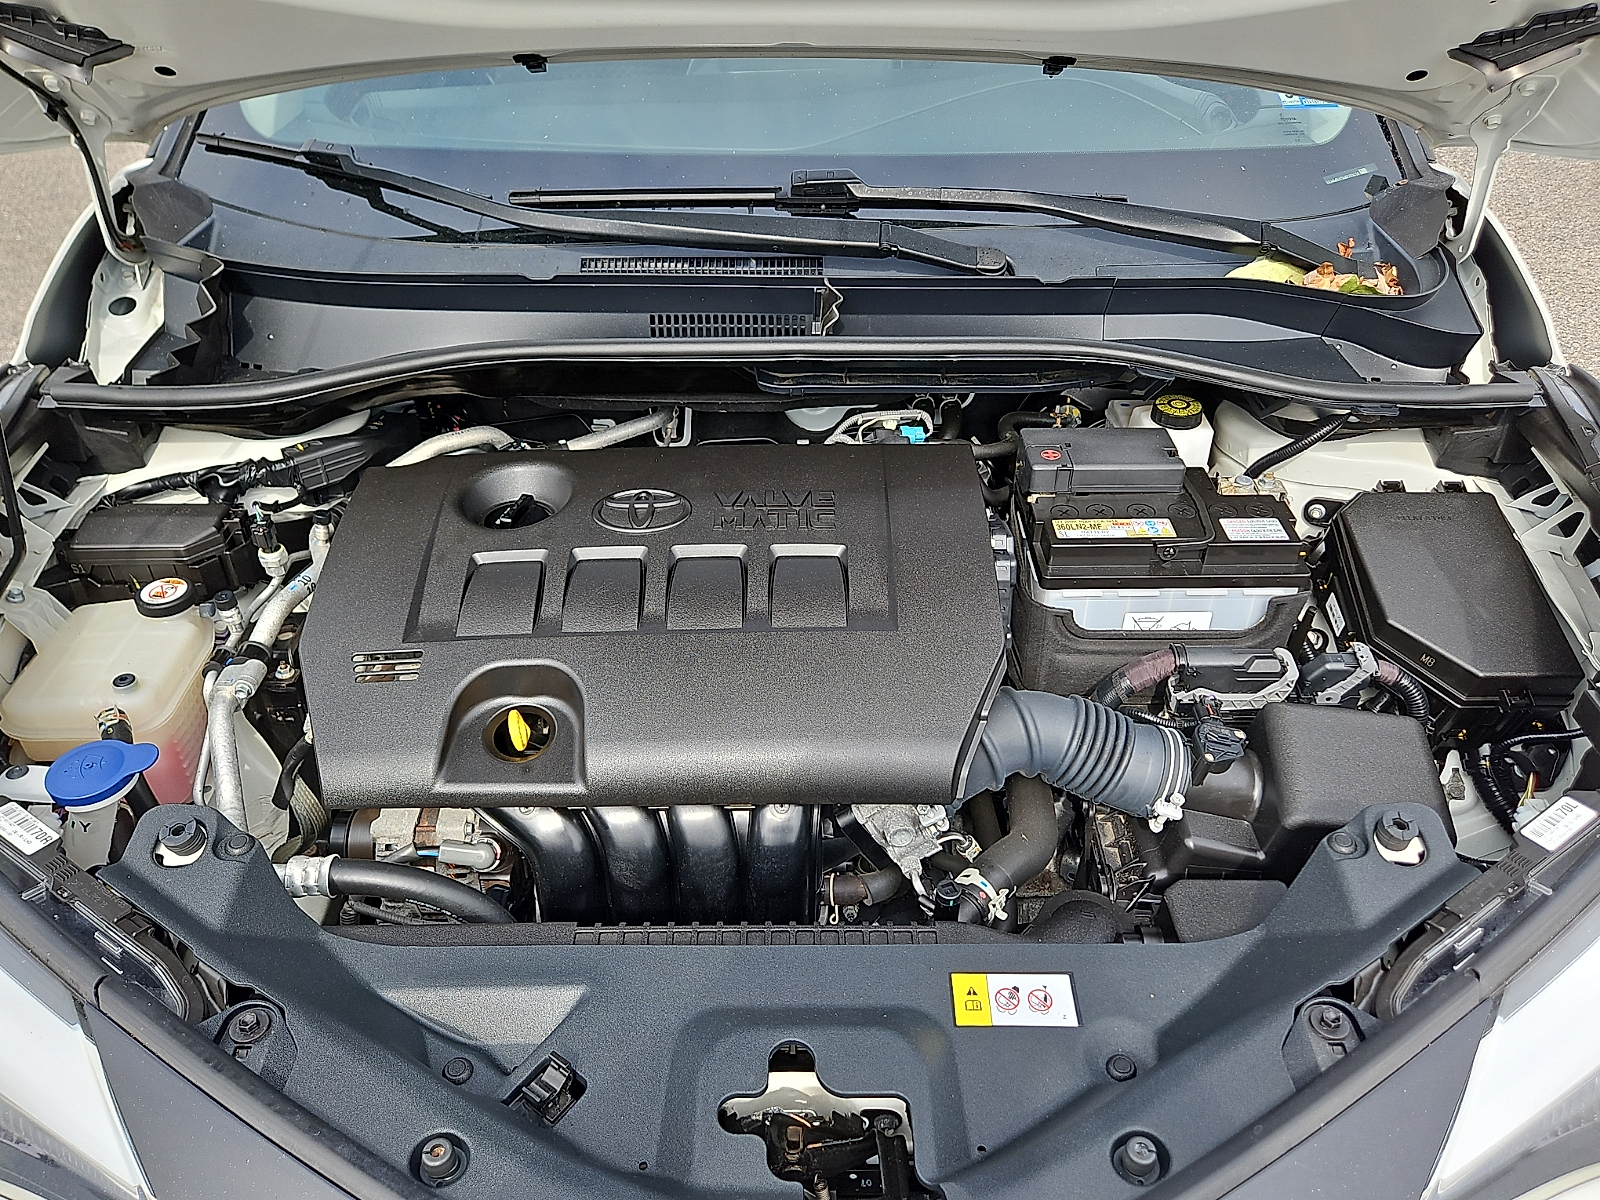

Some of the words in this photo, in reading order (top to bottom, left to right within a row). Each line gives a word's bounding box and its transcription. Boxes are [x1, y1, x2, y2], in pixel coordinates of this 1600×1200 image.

[713, 490, 836, 508] VALVE
[712, 509, 836, 531] MATIC
[1055, 523, 1102, 531] 360LN2-MF
[70, 563, 86, 574] S1
[298, 574, 312, 586] 10
[1556, 801, 1578, 816] 70L
